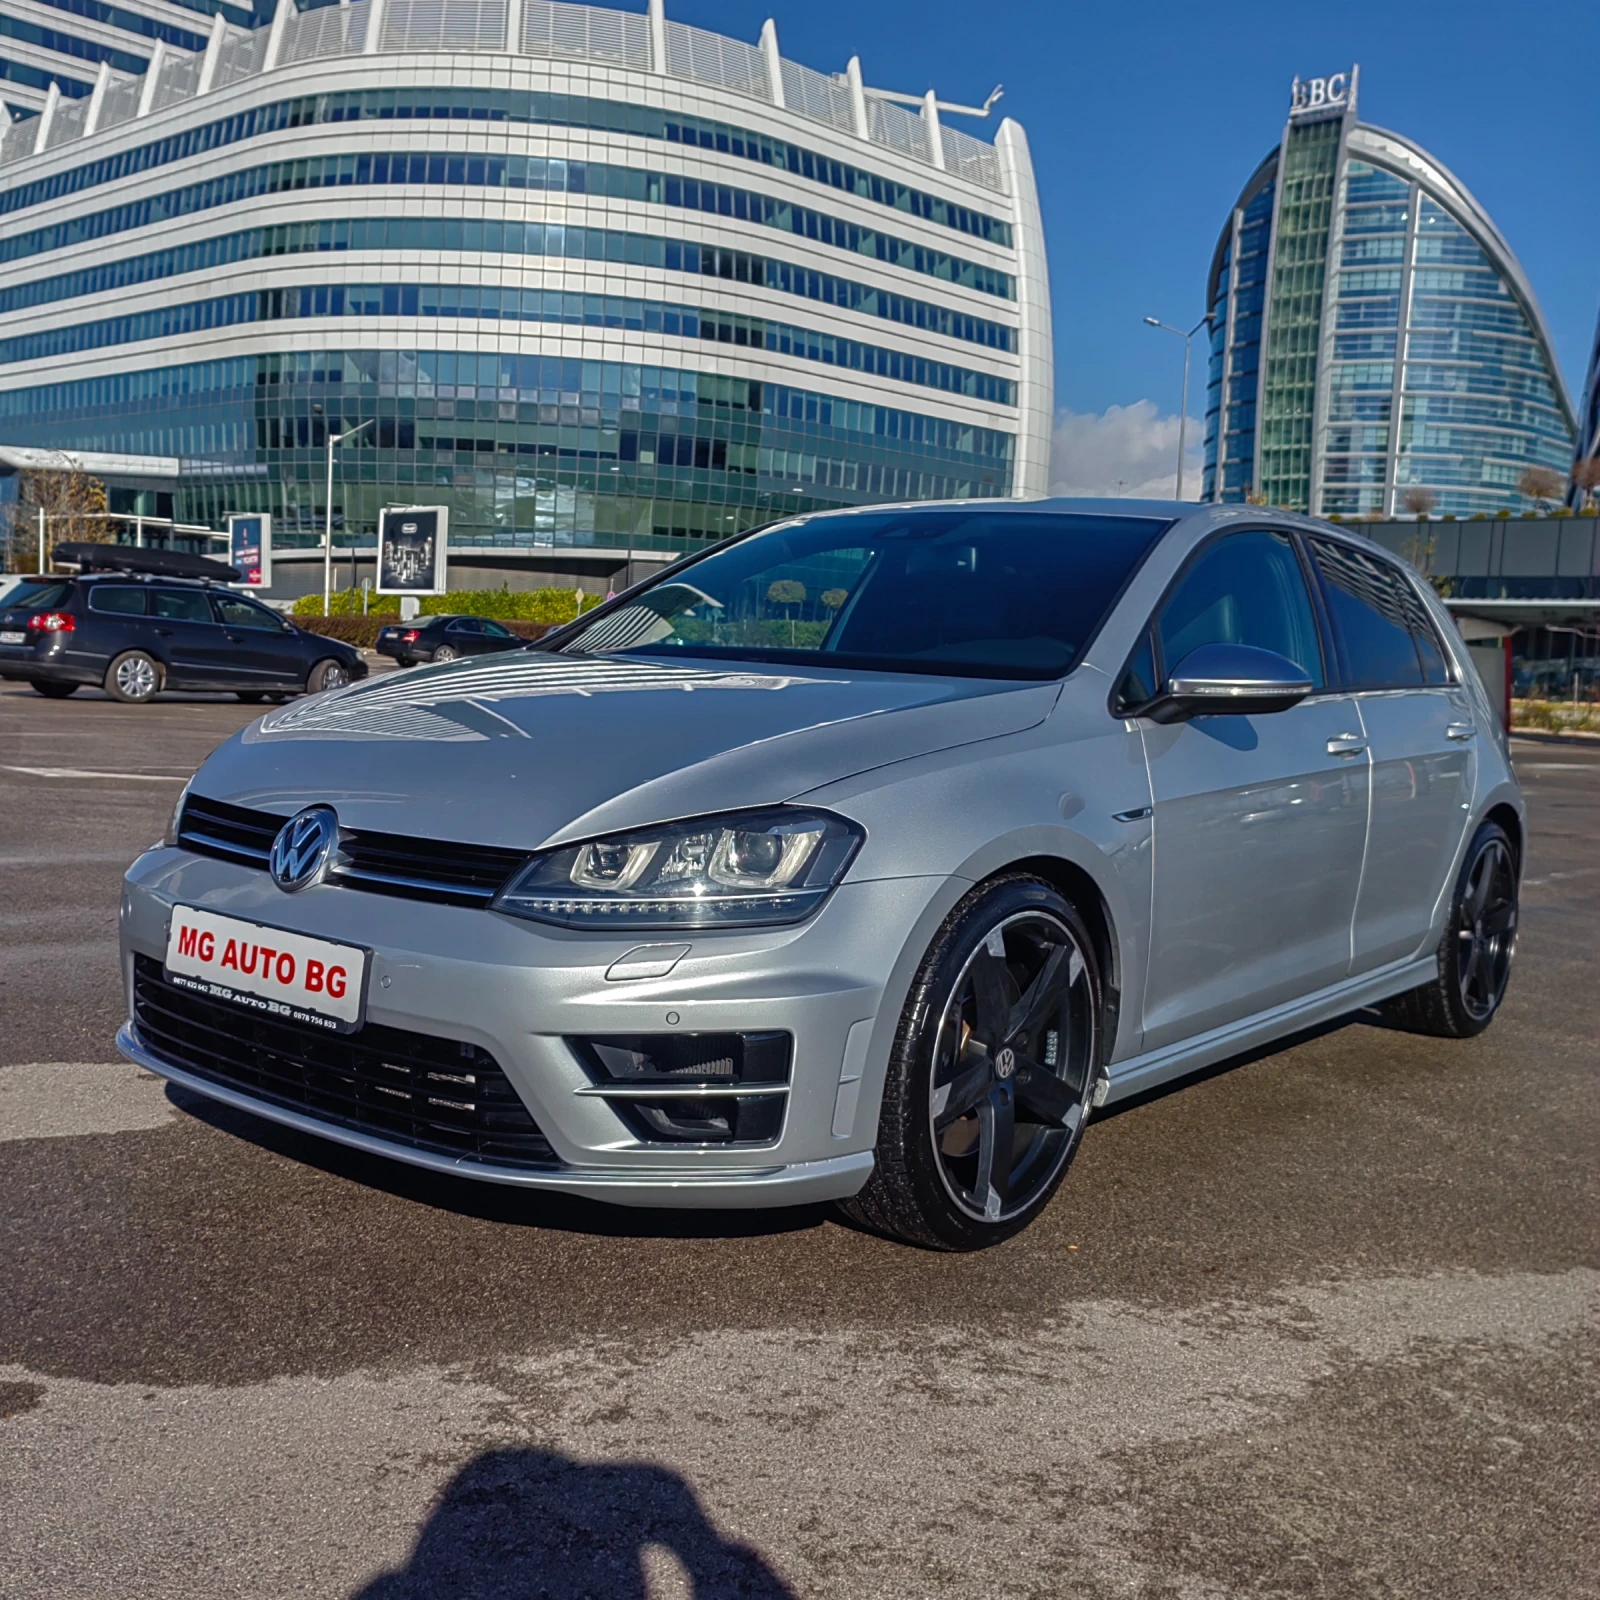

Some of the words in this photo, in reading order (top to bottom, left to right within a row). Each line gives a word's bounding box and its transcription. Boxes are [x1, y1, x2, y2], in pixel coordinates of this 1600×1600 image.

[178, 925, 215, 962] MG
[220, 938, 296, 985] AUTO
[304, 958, 347, 999] BG
[209, 984, 233, 999] MG
[267, 1000, 292, 1017] BG
[293, 1011, 310, 1022] 0878
[310, 1015, 323, 1026] 756
[323, 1019, 337, 1029] 853
